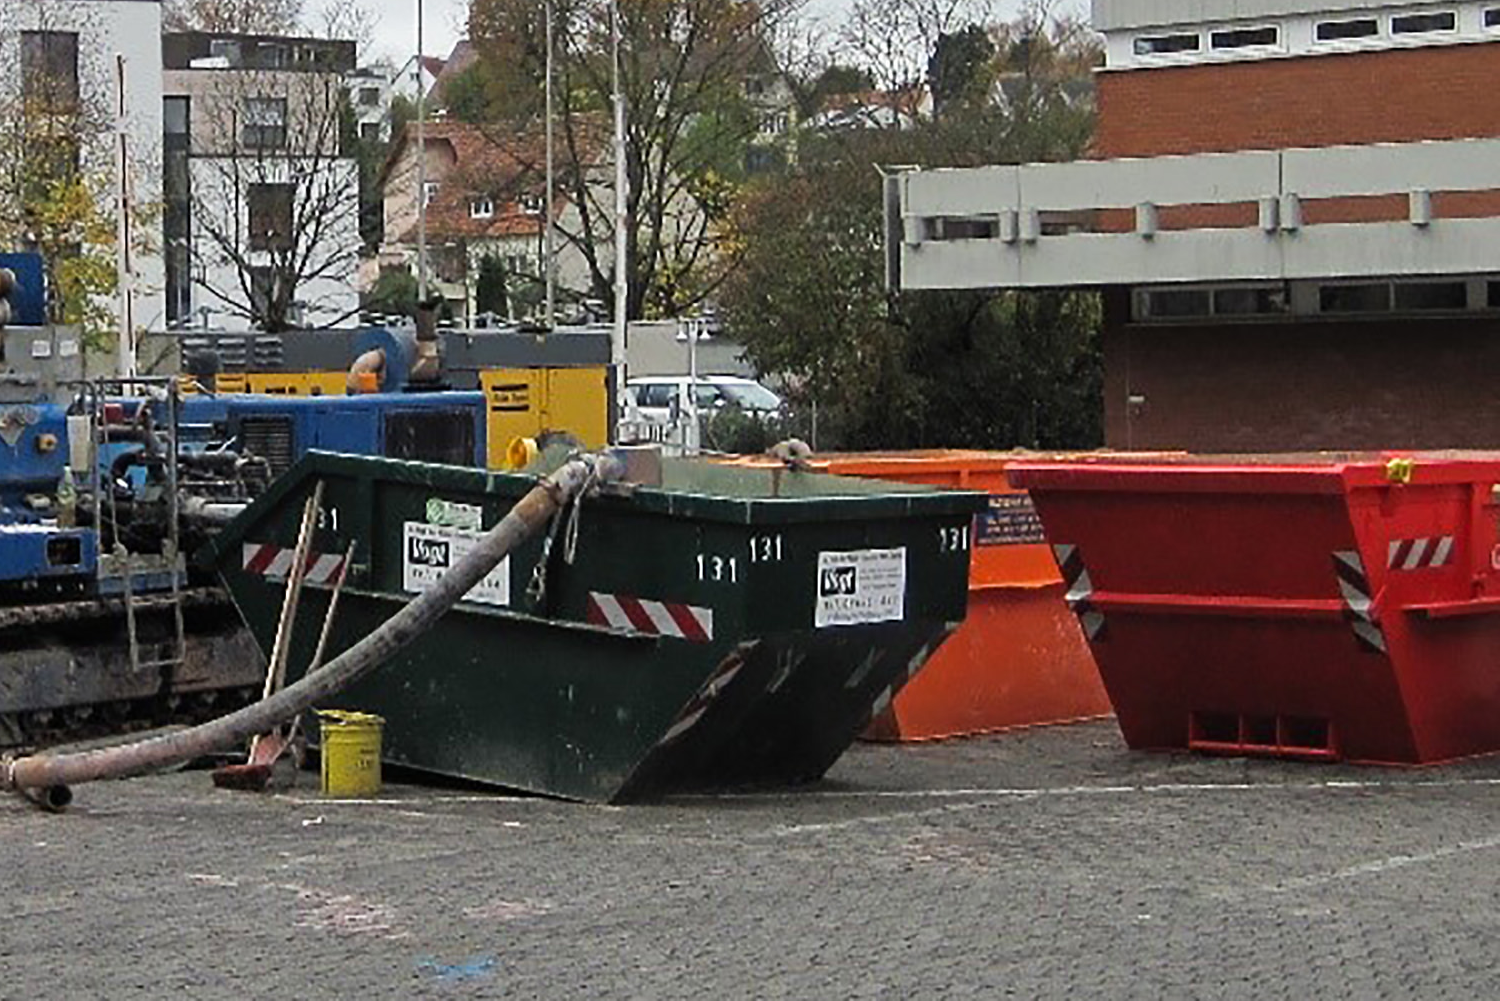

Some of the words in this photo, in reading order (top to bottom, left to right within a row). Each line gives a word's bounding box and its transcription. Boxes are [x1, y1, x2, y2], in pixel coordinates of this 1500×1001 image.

[750, 534, 782, 563] 131
[940, 526, 967, 552] 131
[697, 554, 736, 583] 131
